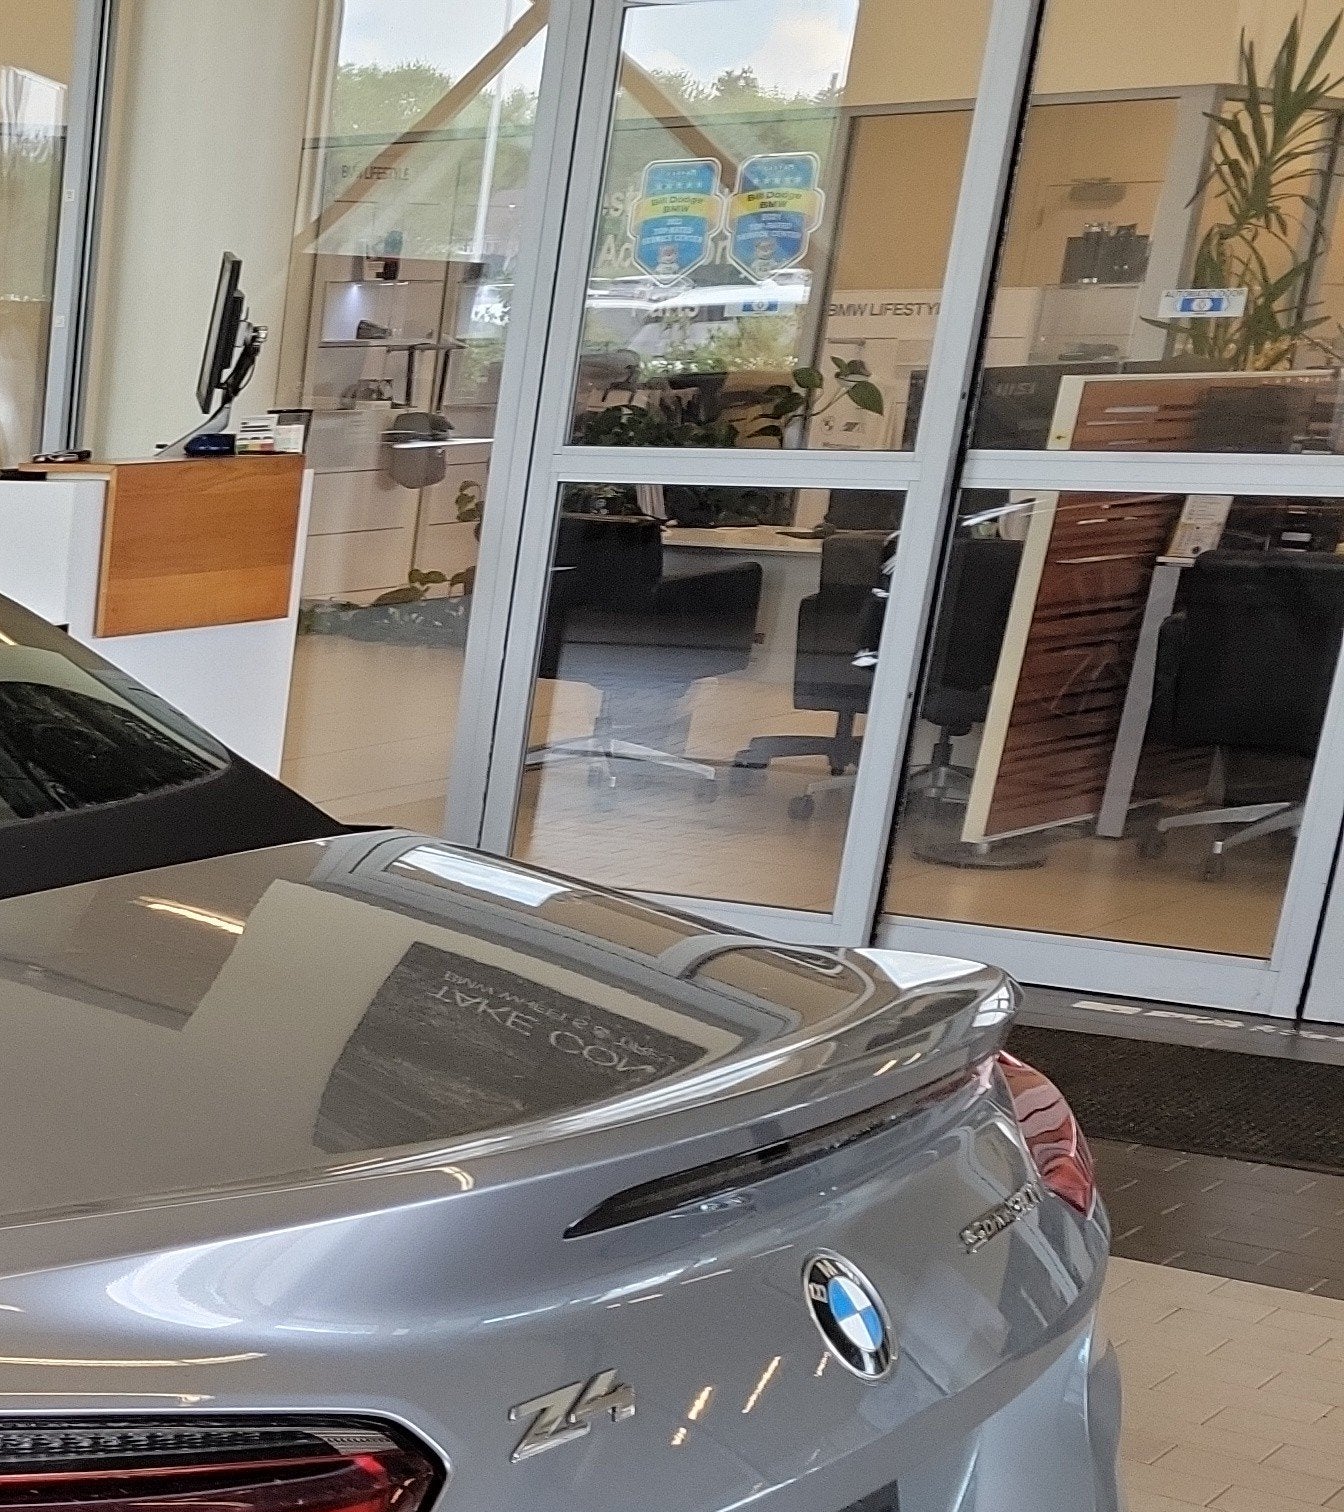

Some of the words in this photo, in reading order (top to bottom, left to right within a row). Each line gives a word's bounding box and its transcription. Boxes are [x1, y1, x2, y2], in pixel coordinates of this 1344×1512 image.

[670, 195, 705, 205] Dodge
[766, 191, 802, 200] Dodge
[760, 200, 789, 209] BMW
[827, 303, 868, 317] BMW
[508, 1367, 636, 1463] Z4
